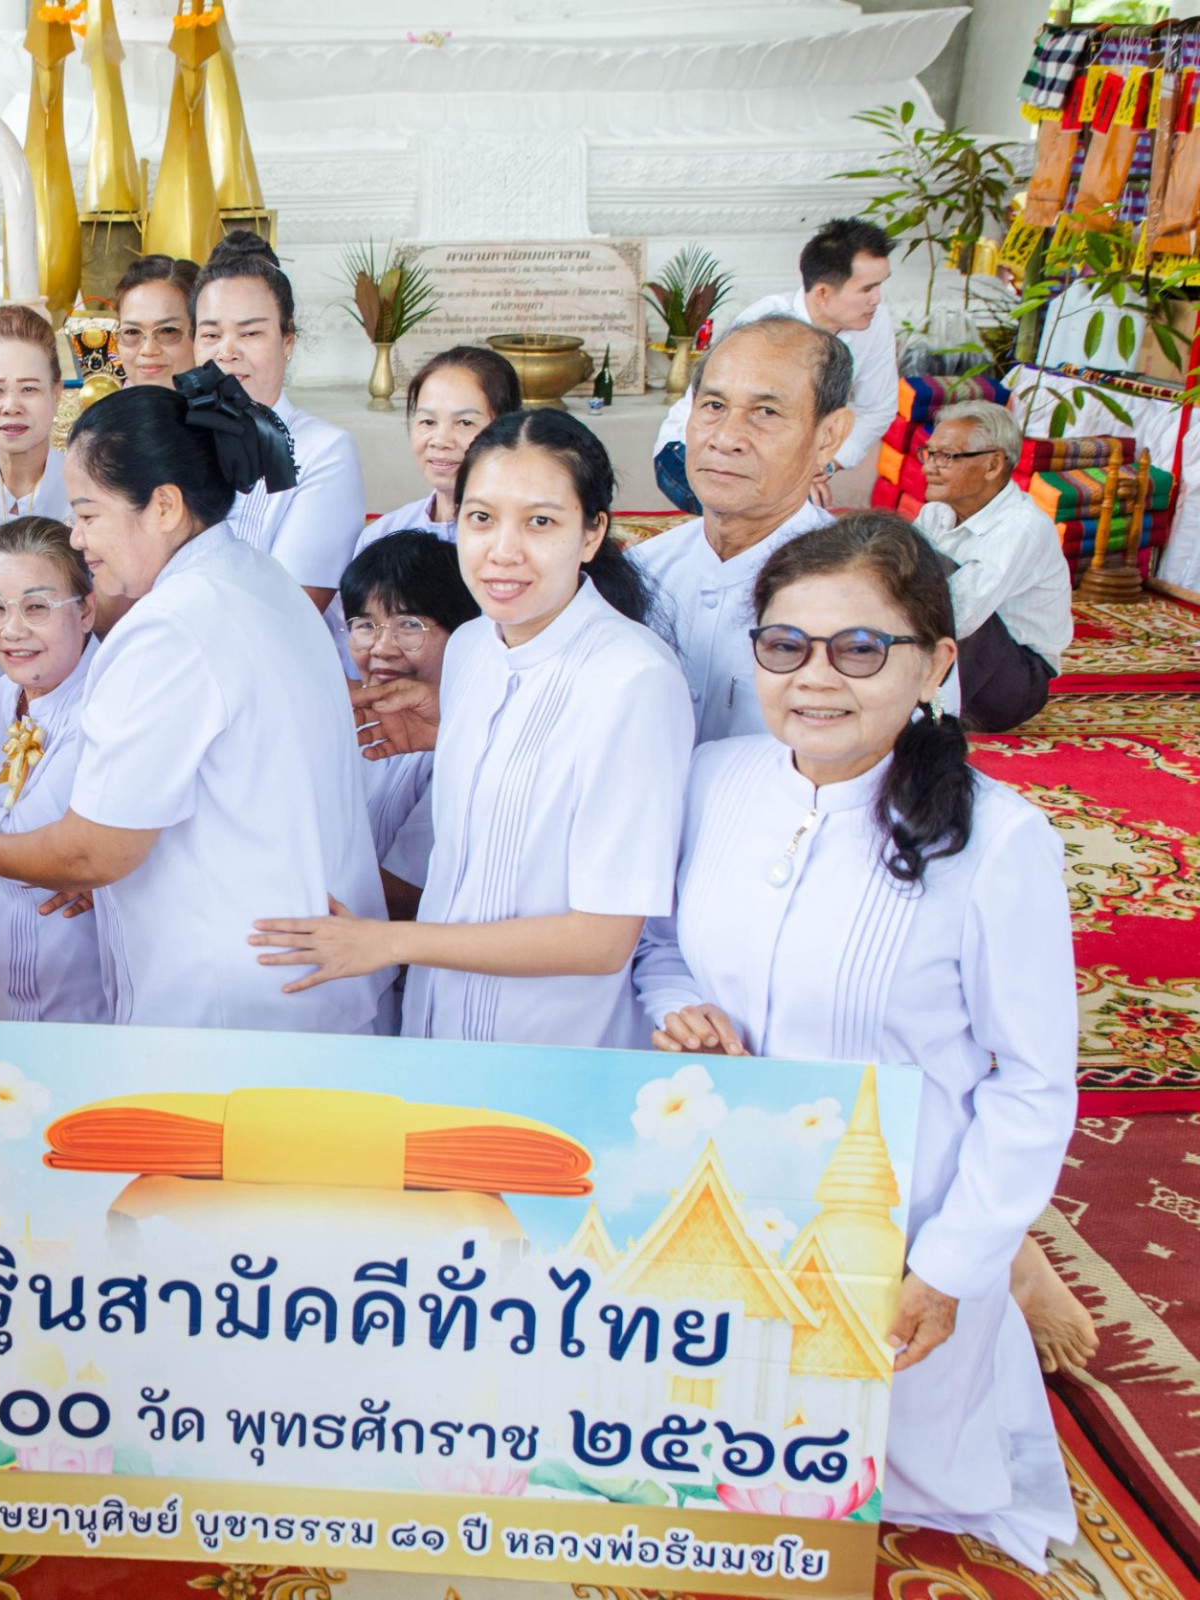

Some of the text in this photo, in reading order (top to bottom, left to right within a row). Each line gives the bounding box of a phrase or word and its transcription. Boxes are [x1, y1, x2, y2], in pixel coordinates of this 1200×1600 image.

[137, 1386, 205, 1443] วัด
[226, 1398, 540, 1467] พุทธศักราช
[569, 1410, 850, 1484] ๒๕๖๘
[195, 1512, 373, 1549] บูชาธรรม
[391, 1525, 445, 1551] ๘๑
[462, 1516, 487, 1551] ปี
[505, 1528, 824, 1577] หลวงพ่อธัมมชโย
